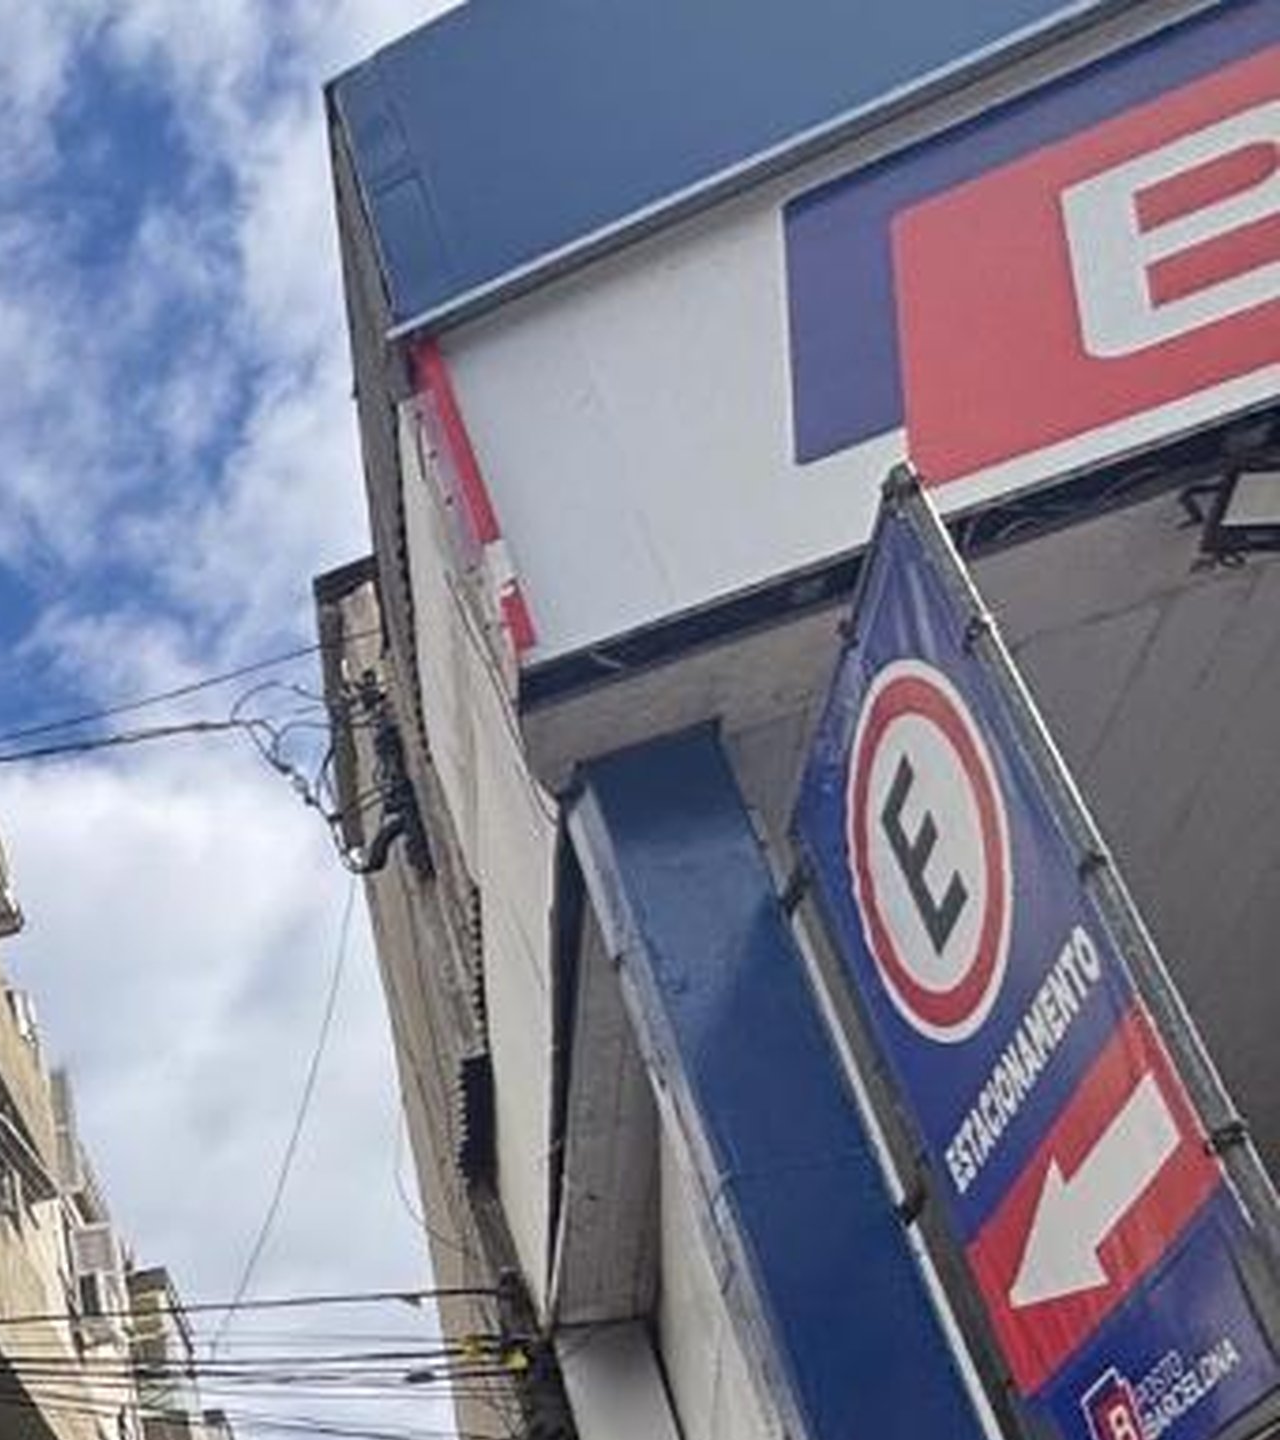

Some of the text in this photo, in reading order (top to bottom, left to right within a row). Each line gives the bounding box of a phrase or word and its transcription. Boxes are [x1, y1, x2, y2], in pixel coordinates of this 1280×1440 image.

[881, 751, 969, 957] E
[945, 925, 1101, 1194] ESTACIONAMENTO
[1142, 1337, 1240, 1440] BARCELONA
